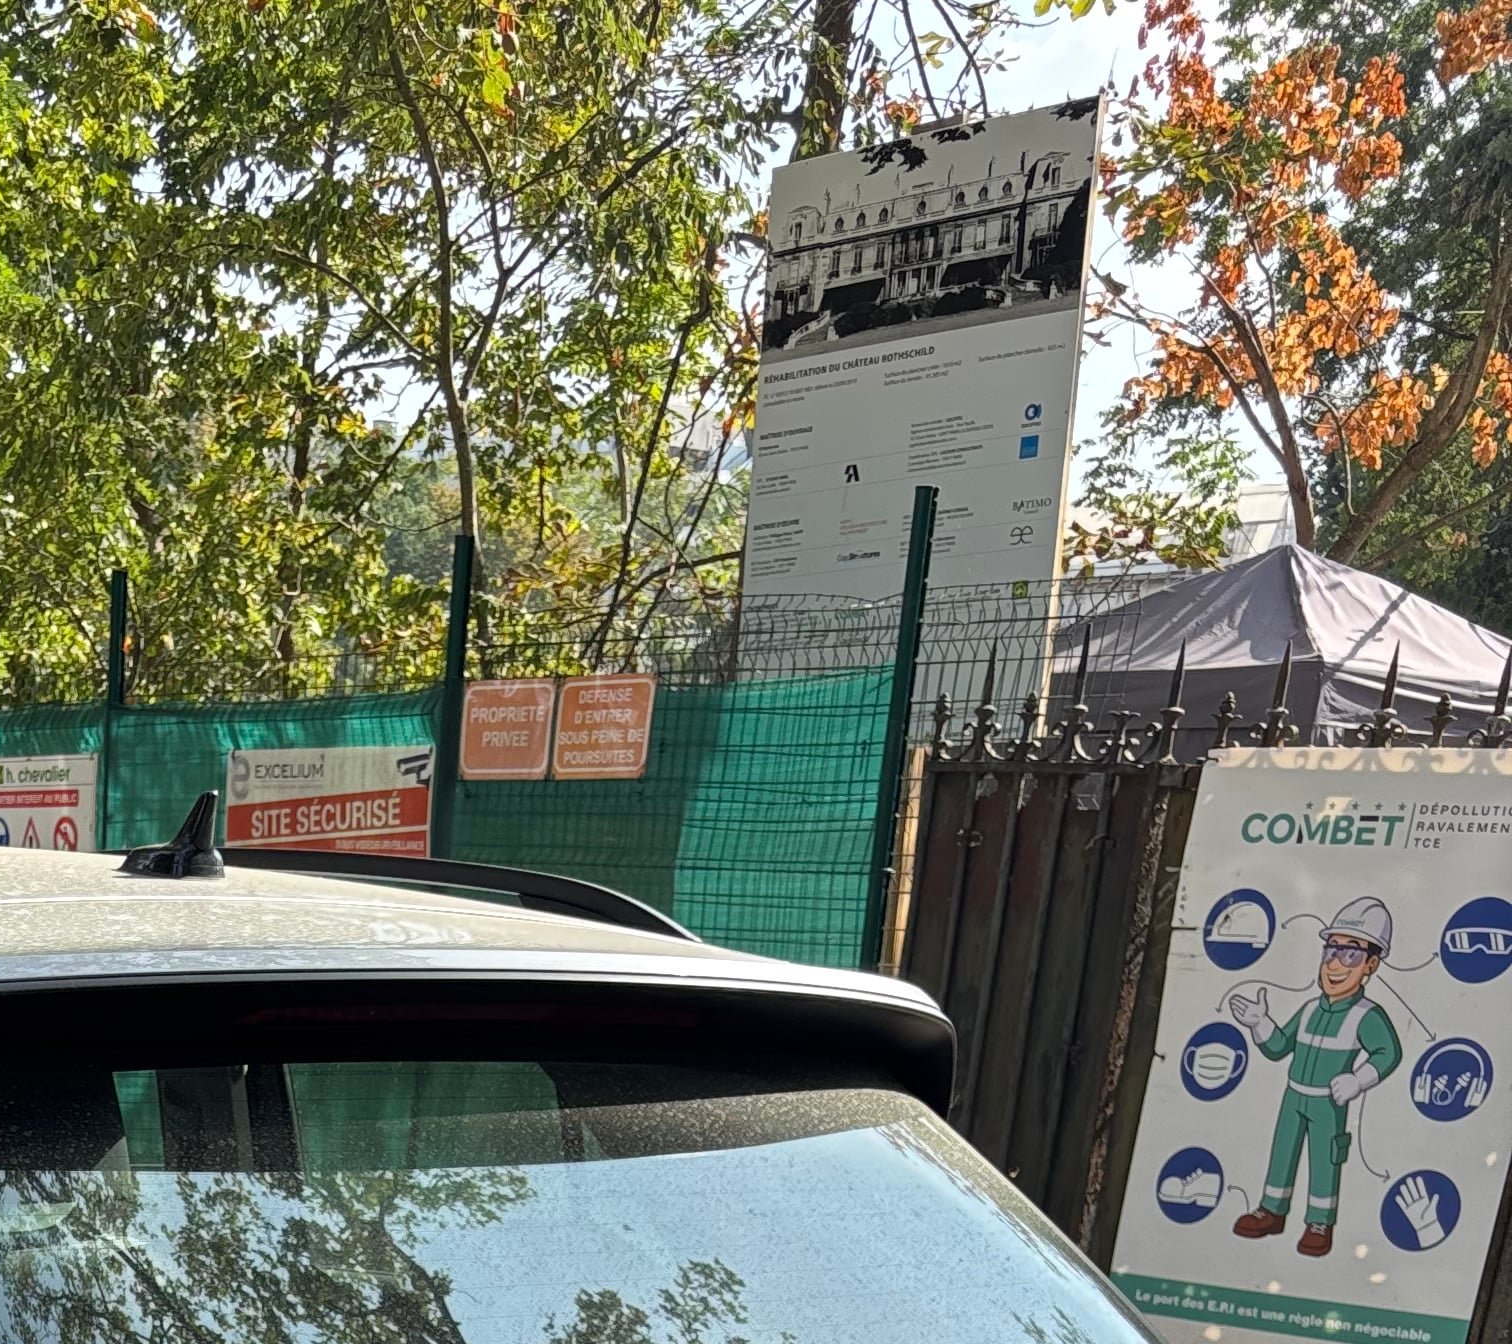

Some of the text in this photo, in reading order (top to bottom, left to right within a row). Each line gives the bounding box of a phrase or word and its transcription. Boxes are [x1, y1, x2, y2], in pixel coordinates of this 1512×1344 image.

[763, 365, 827, 384] RÉHABILITATION
[828, 361, 841, 373] DU
[842, 354, 880, 370] CHÂTEAU
[881, 346, 935, 364] ROTHSCHILD
[578, 687, 633, 705] DEFENSE
[470, 705, 545, 724] PROPRIETE
[574, 708, 632, 725] D'ENTRER
[481, 731, 529, 748] PRIVEE
[559, 728, 644, 745] SOUS PEINE DE
[562, 749, 635, 765] POURSUITES
[17, 766, 71, 783] chevalier
[254, 764, 324, 779] EXCELIUM
[251, 791, 401, 838] SITE SÉCURISÉ
[1241, 812, 1405, 846] COMBET
[1413, 837, 1441, 849] TCE
[1135, 1288, 1150, 1302] Le
[1152, 1290, 1179, 1307] port
[1181, 1296, 1204, 1310] des
[1237, 1305, 1257, 1318] est
[1261, 1309, 1285, 1321] une
[1289, 1311, 1322, 1327] règle
[1324, 1317, 1350, 1331] non
[1354, 1319, 1431, 1343] négociable
